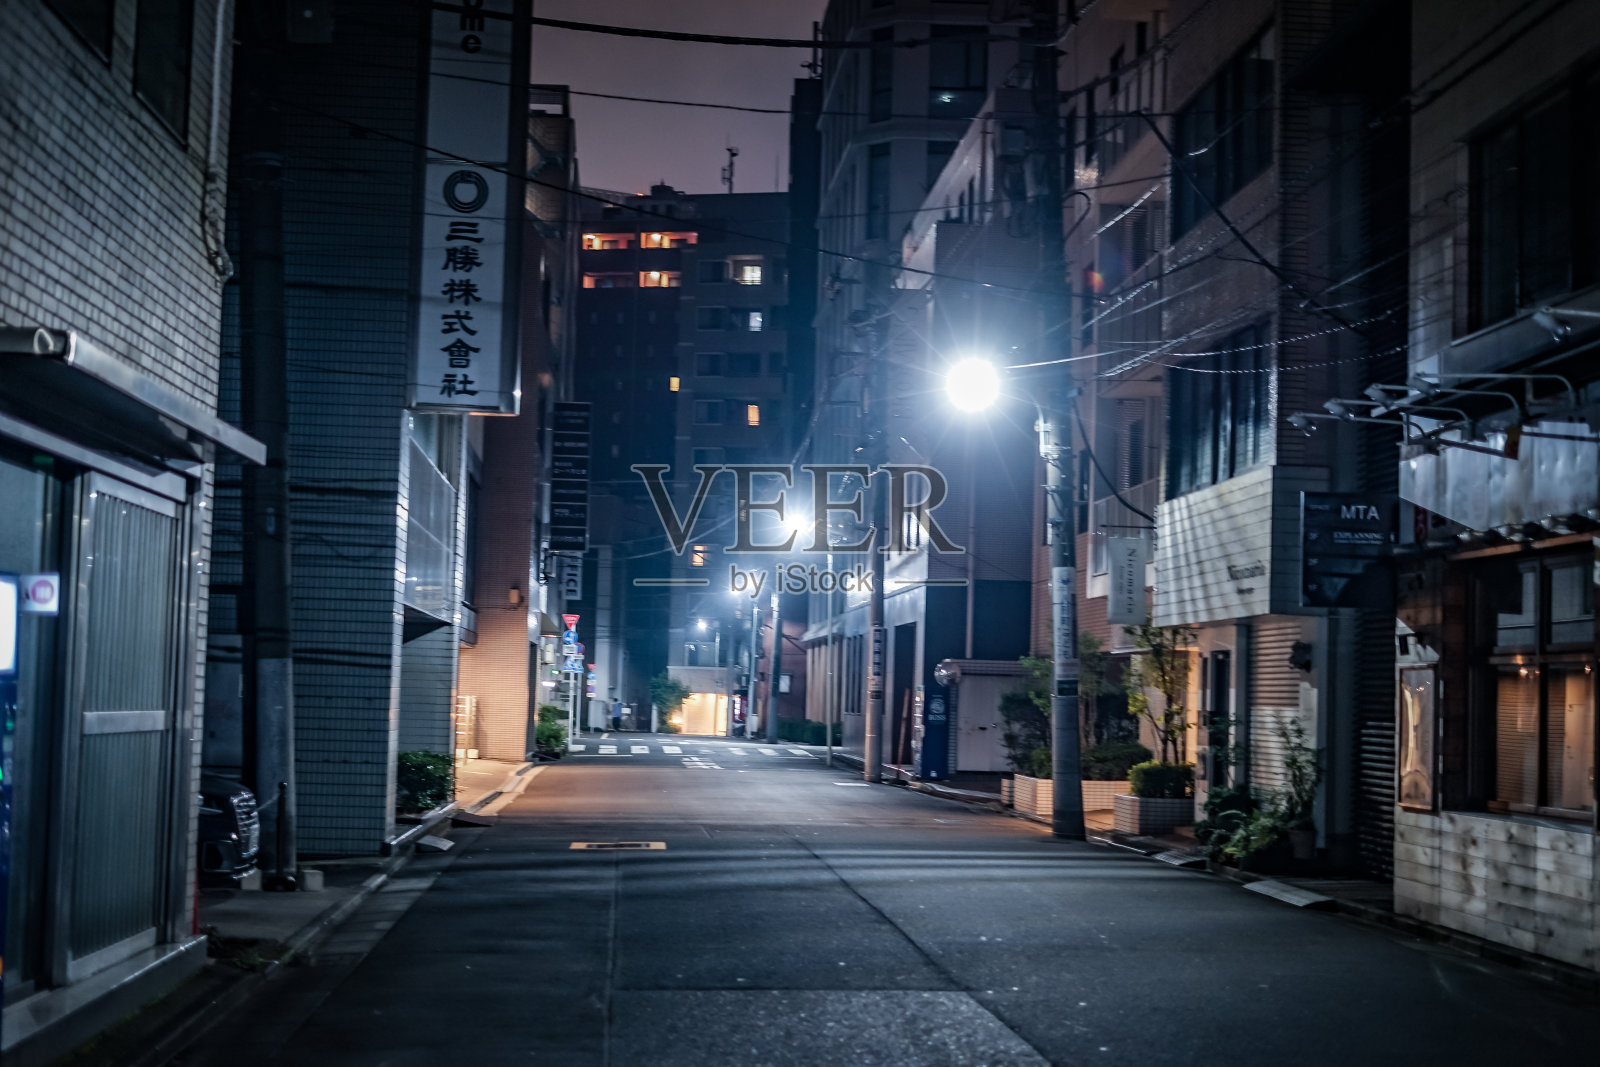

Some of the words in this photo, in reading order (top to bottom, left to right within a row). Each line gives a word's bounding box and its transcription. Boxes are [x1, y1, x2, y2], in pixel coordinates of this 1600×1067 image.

[440, 221, 485, 398] 三勝株式會社
[1341, 504, 1380, 520] MTA
